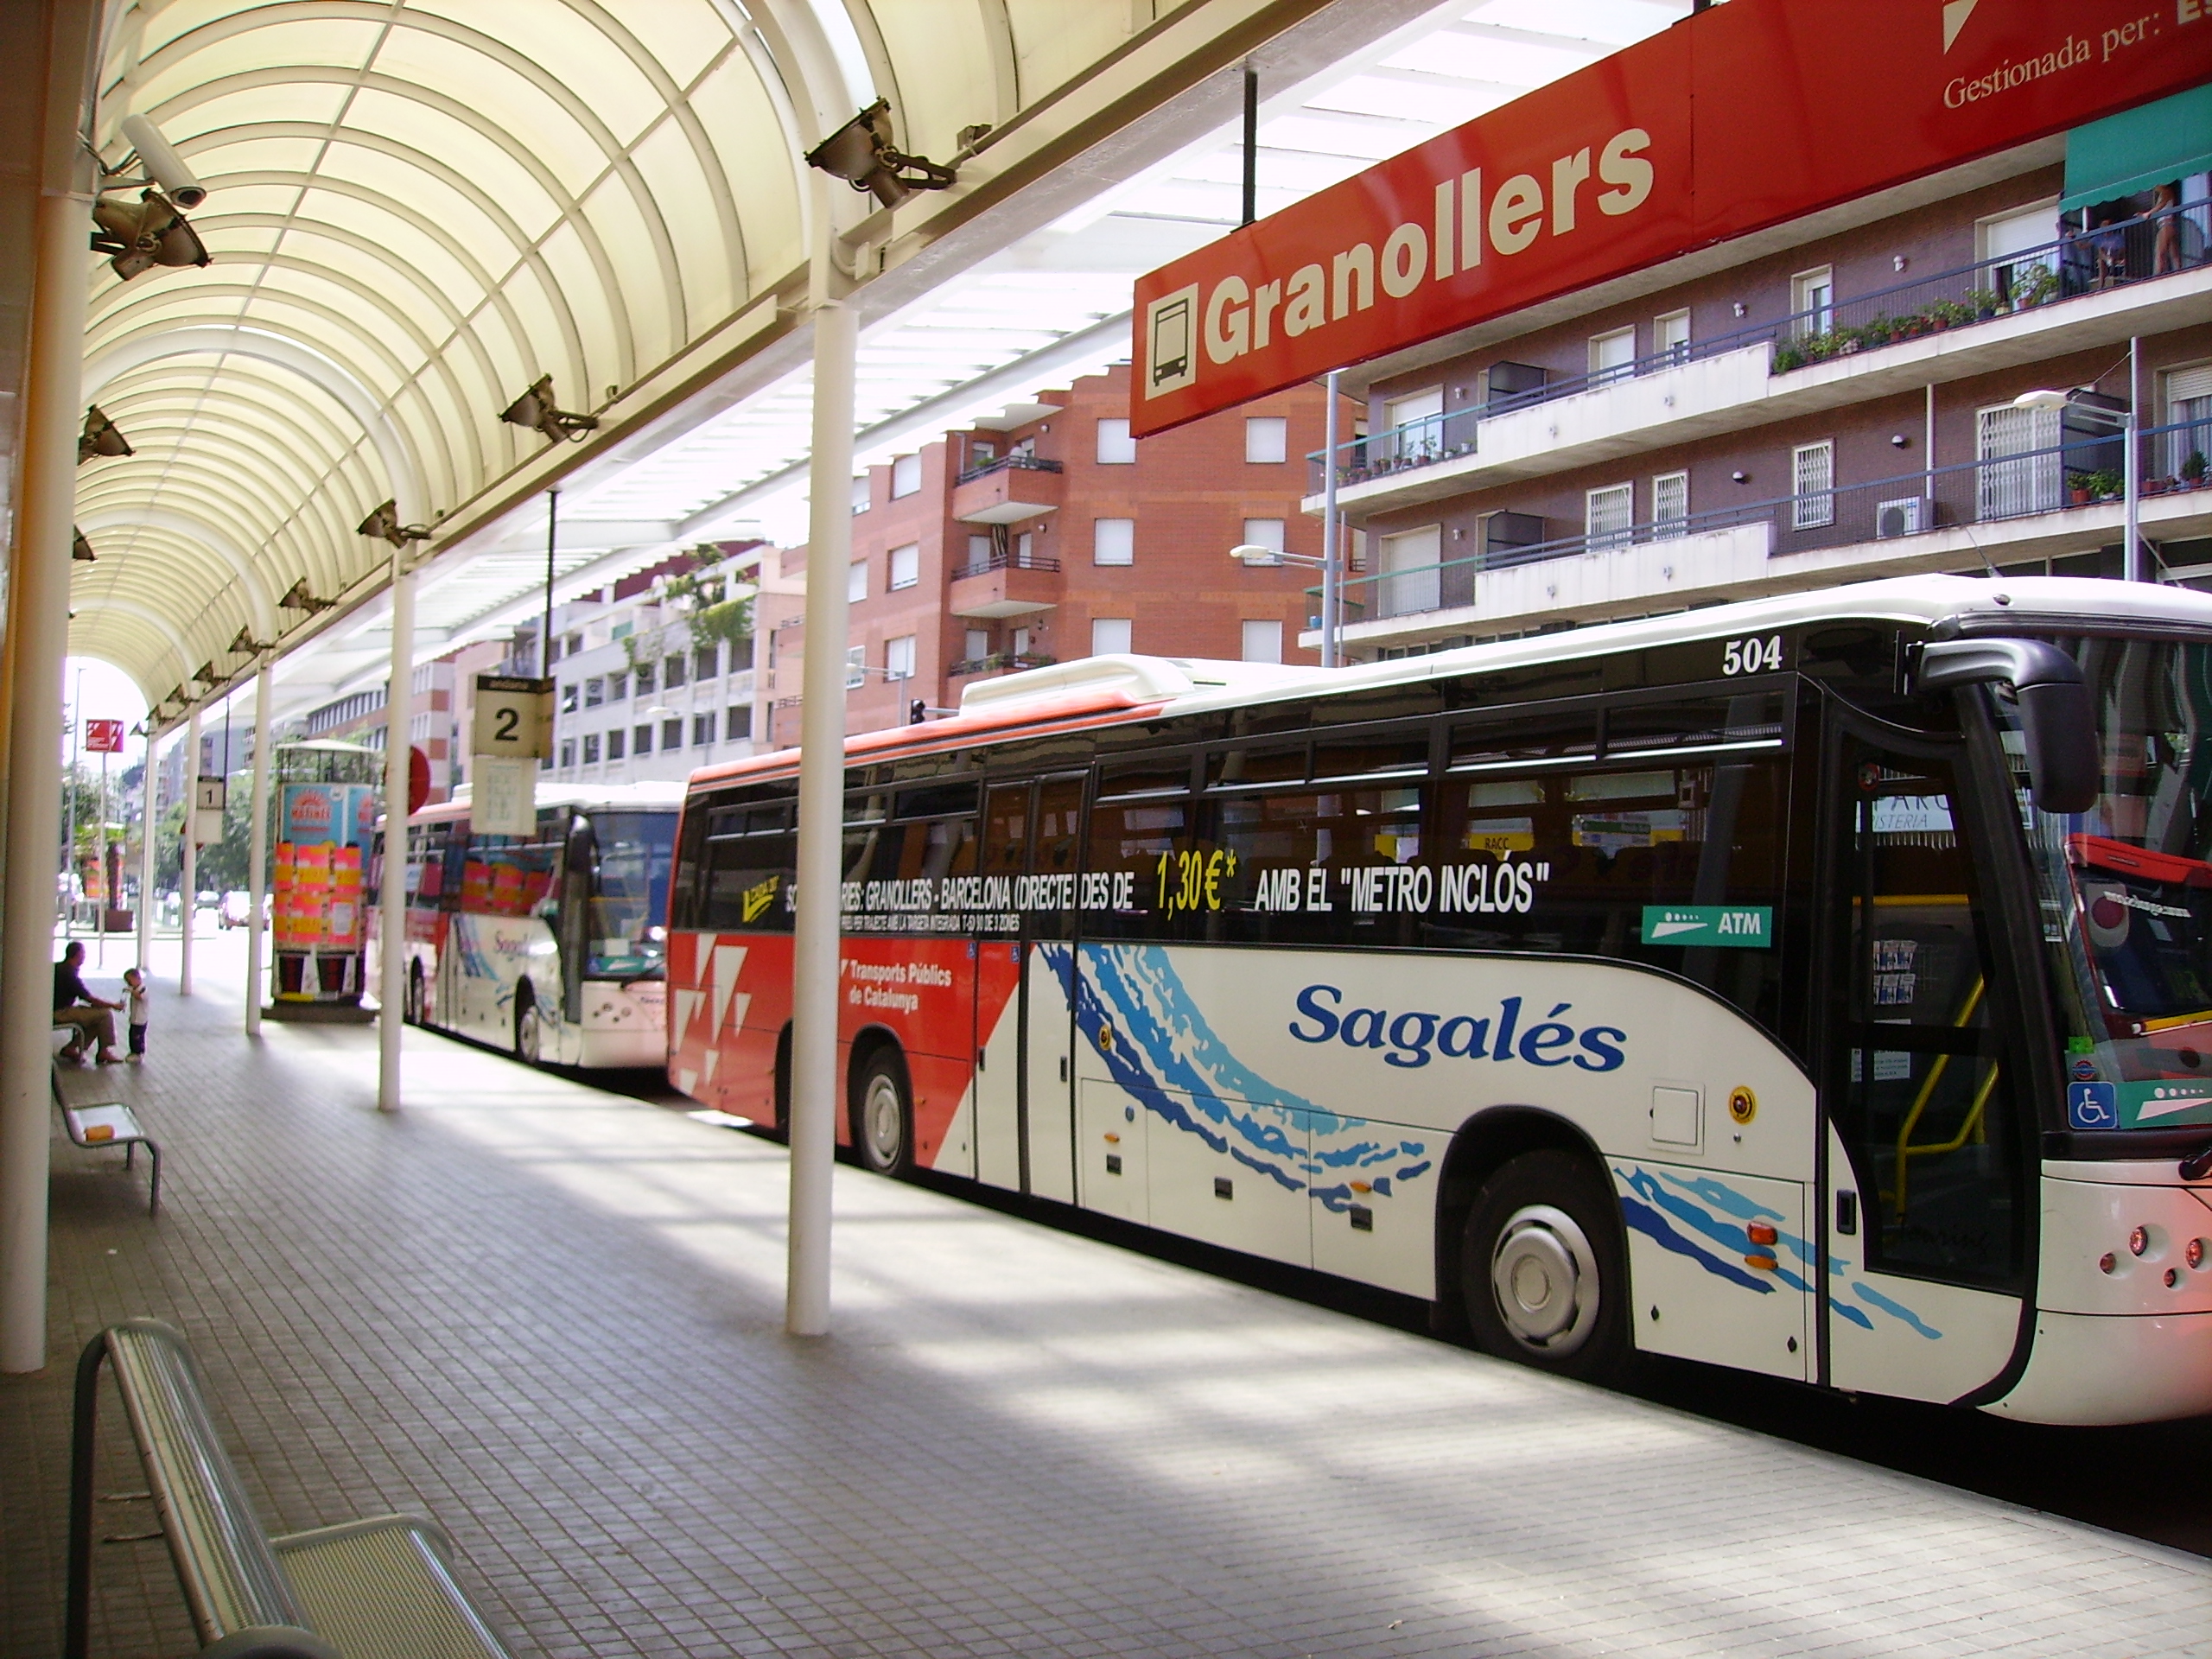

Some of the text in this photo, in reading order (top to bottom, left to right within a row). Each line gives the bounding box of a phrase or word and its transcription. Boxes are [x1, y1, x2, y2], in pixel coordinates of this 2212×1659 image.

[1943, 35, 2091, 109] Gestionada
[2101, 13, 2159, 62] per:
[1203, 127, 1655, 365] Granollers
[1722, 635, 1783, 676] 504
[494, 708, 518, 741] 2
[206, 789, 213, 804] 1
[1484, 836, 1510, 850] RACC
[866, 877, 933, 912] GRANOLLERS
[941, 874, 1011, 911] BARCELONA
[1014, 873, 1077, 911] (DRECTE)
[1080, 872, 1110, 910] DES
[1112, 871, 1135, 910] DE
[1255, 868, 1299, 912] AMB
[1306, 868, 1333, 912] EL
[1340, 865, 1433, 913] "METRO
[1440, 852, 1550, 914] INCLÓS"
[1716, 912, 1762, 935] ATM
[850, 959, 951, 987] Transports Públics
[849, 984, 918, 1015] de Catalunya
[1287, 984, 1628, 1072] Sagalés
